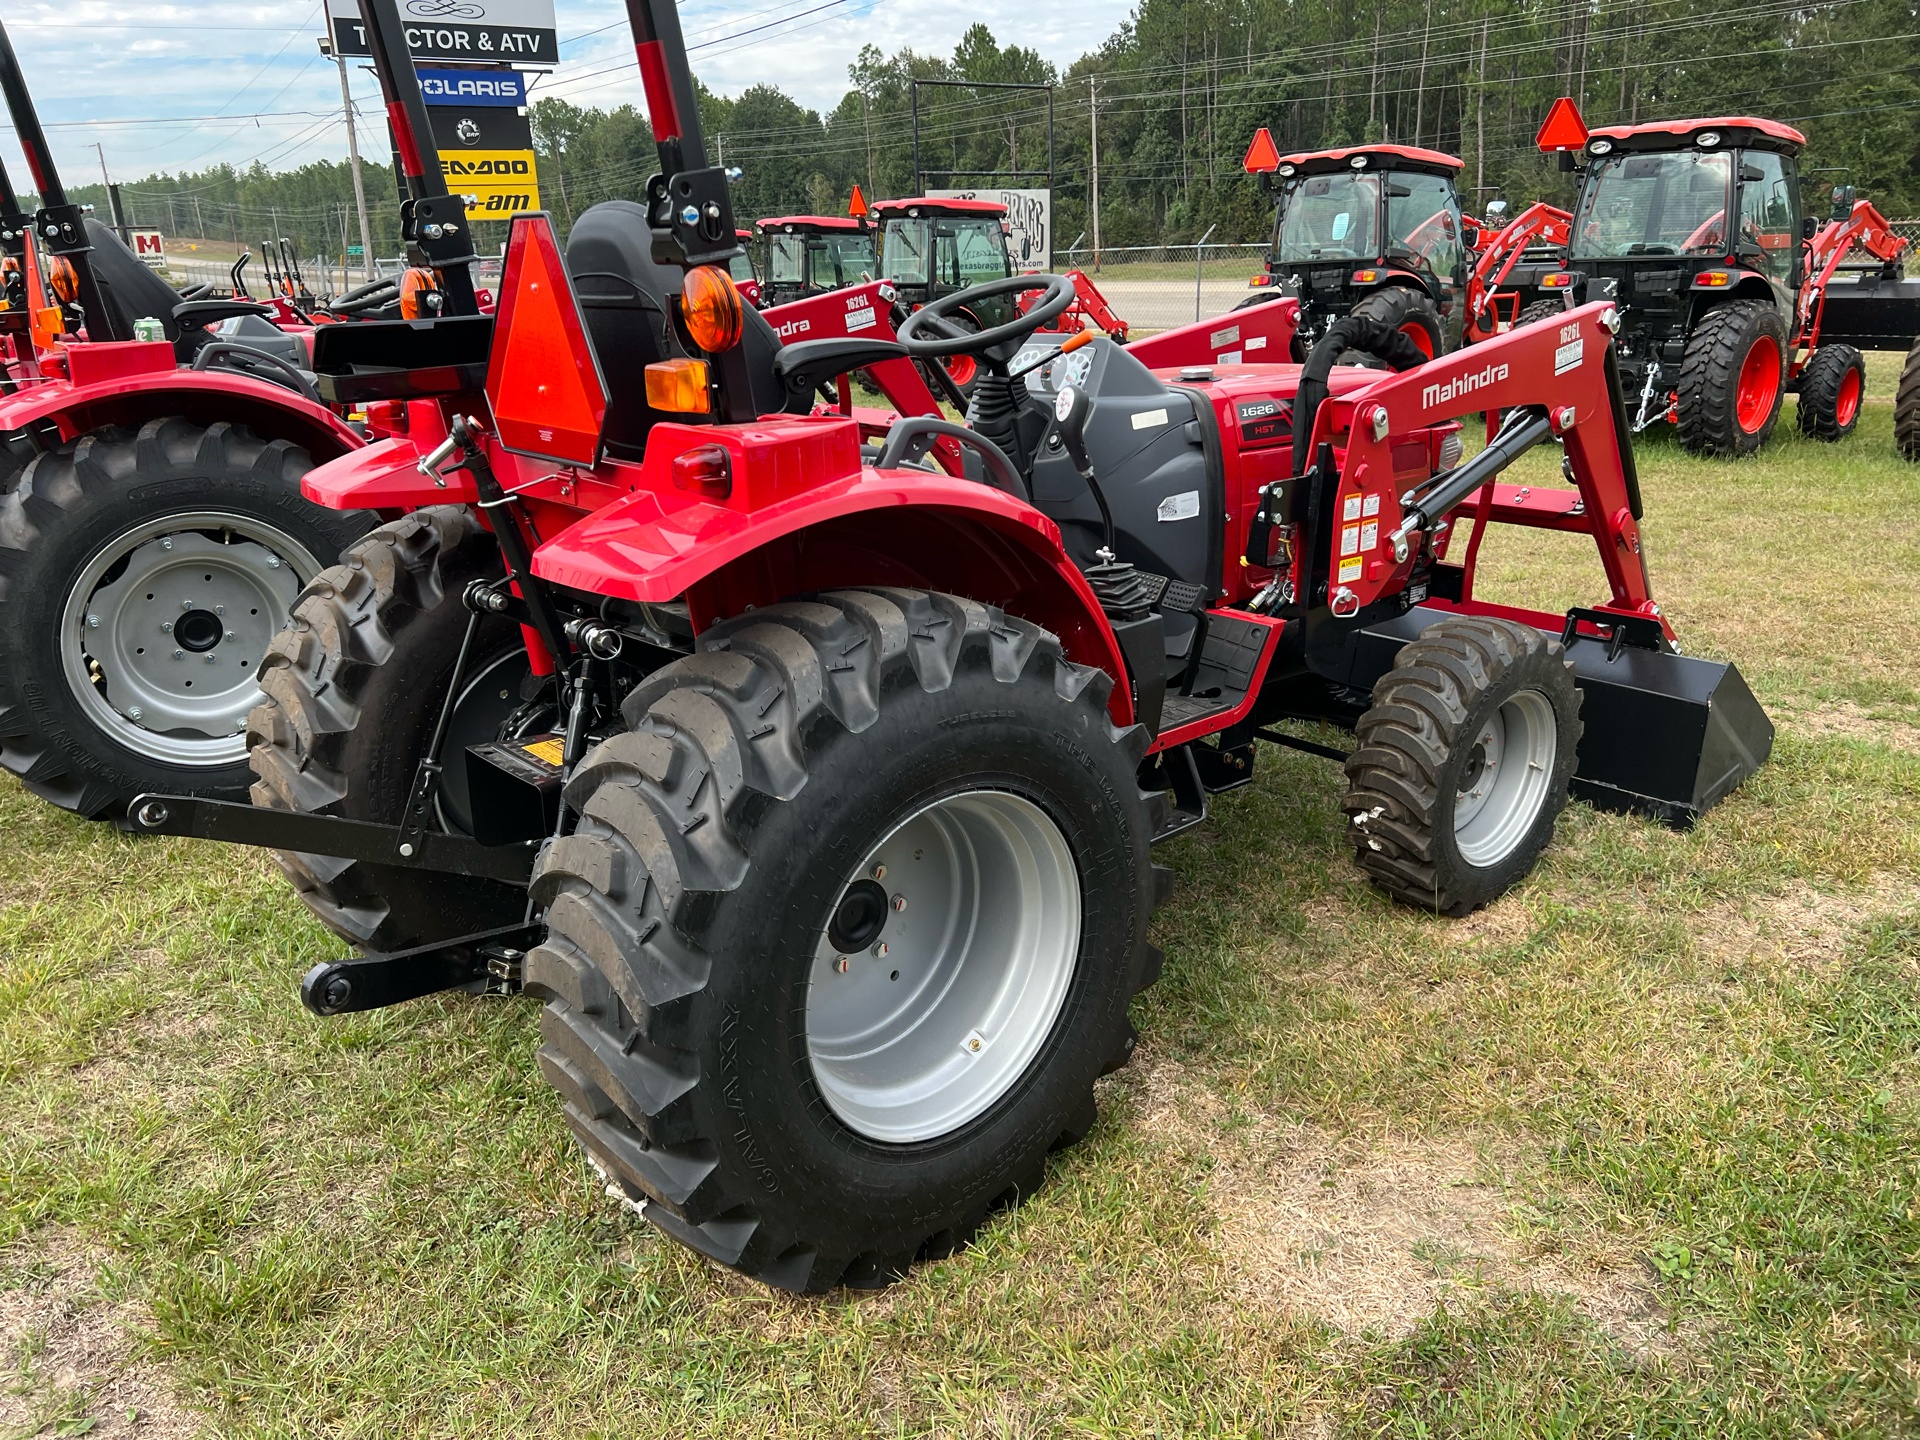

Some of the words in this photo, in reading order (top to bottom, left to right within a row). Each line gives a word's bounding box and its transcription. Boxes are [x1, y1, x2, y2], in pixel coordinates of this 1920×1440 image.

[353, 26, 470, 50] TCTOR
[477, 34, 494, 51] &
[500, 34, 541, 53] ATV
[418, 80, 518, 97] OLARIS
[1001, 192, 1044, 252] BRAGG
[845, 293, 869, 311] 1626L
[773, 319, 811, 338] ndra
[1559, 321, 1580, 345] 1626L
[1422, 363, 1509, 410] Mahindra
[1241, 404, 1274, 417] 1626
[1254, 424, 1275, 435] HST
[1053, 729, 1097, 776] THE
[719, 999, 780, 1194] GALAXY
